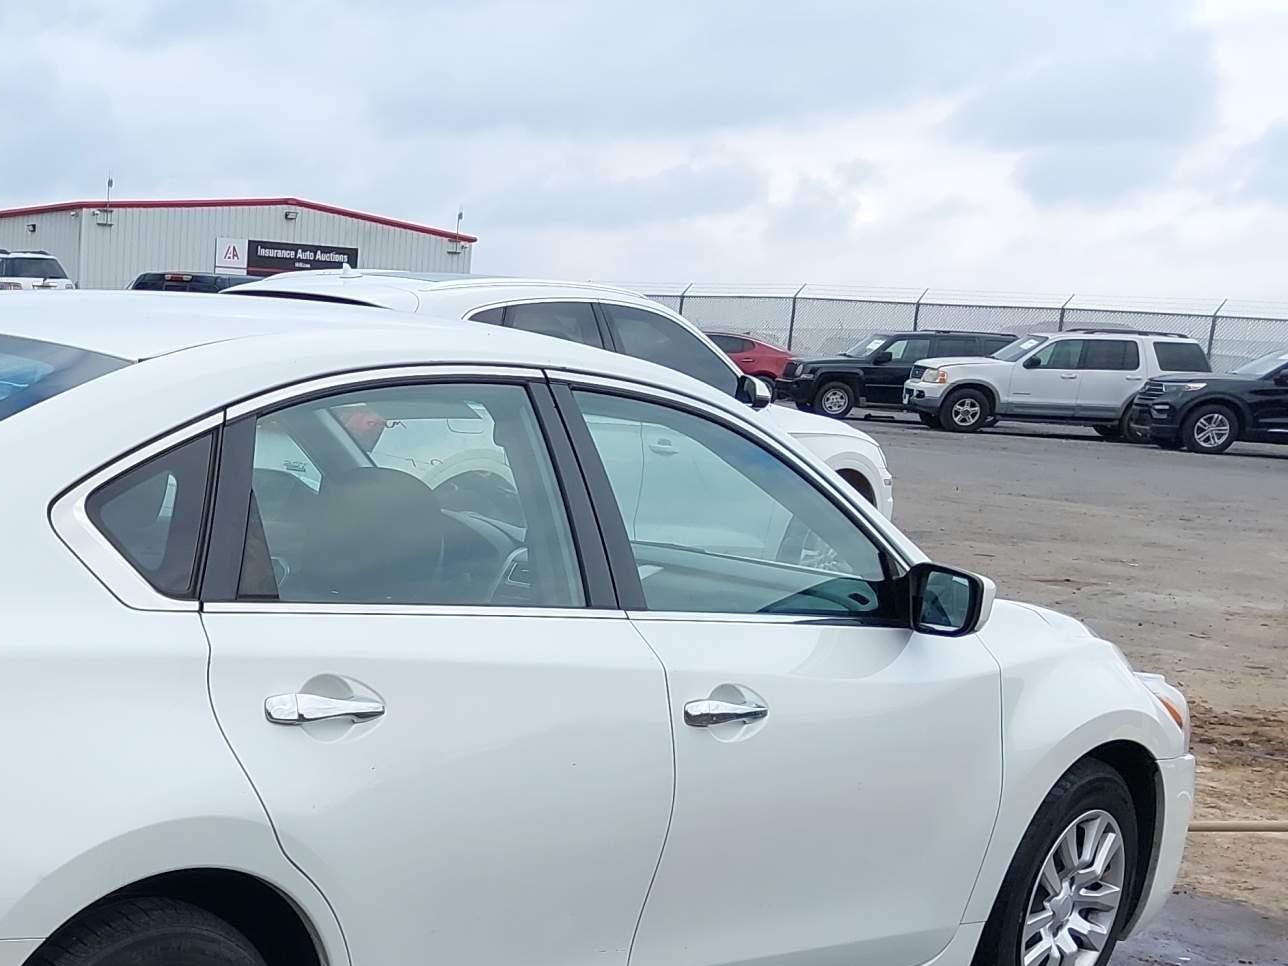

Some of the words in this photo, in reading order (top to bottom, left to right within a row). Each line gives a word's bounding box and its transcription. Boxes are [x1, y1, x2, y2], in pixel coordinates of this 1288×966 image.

[257, 245, 295, 258] Insurance
[296, 249, 314, 260] Auto
[315, 250, 348, 262] Auctions
